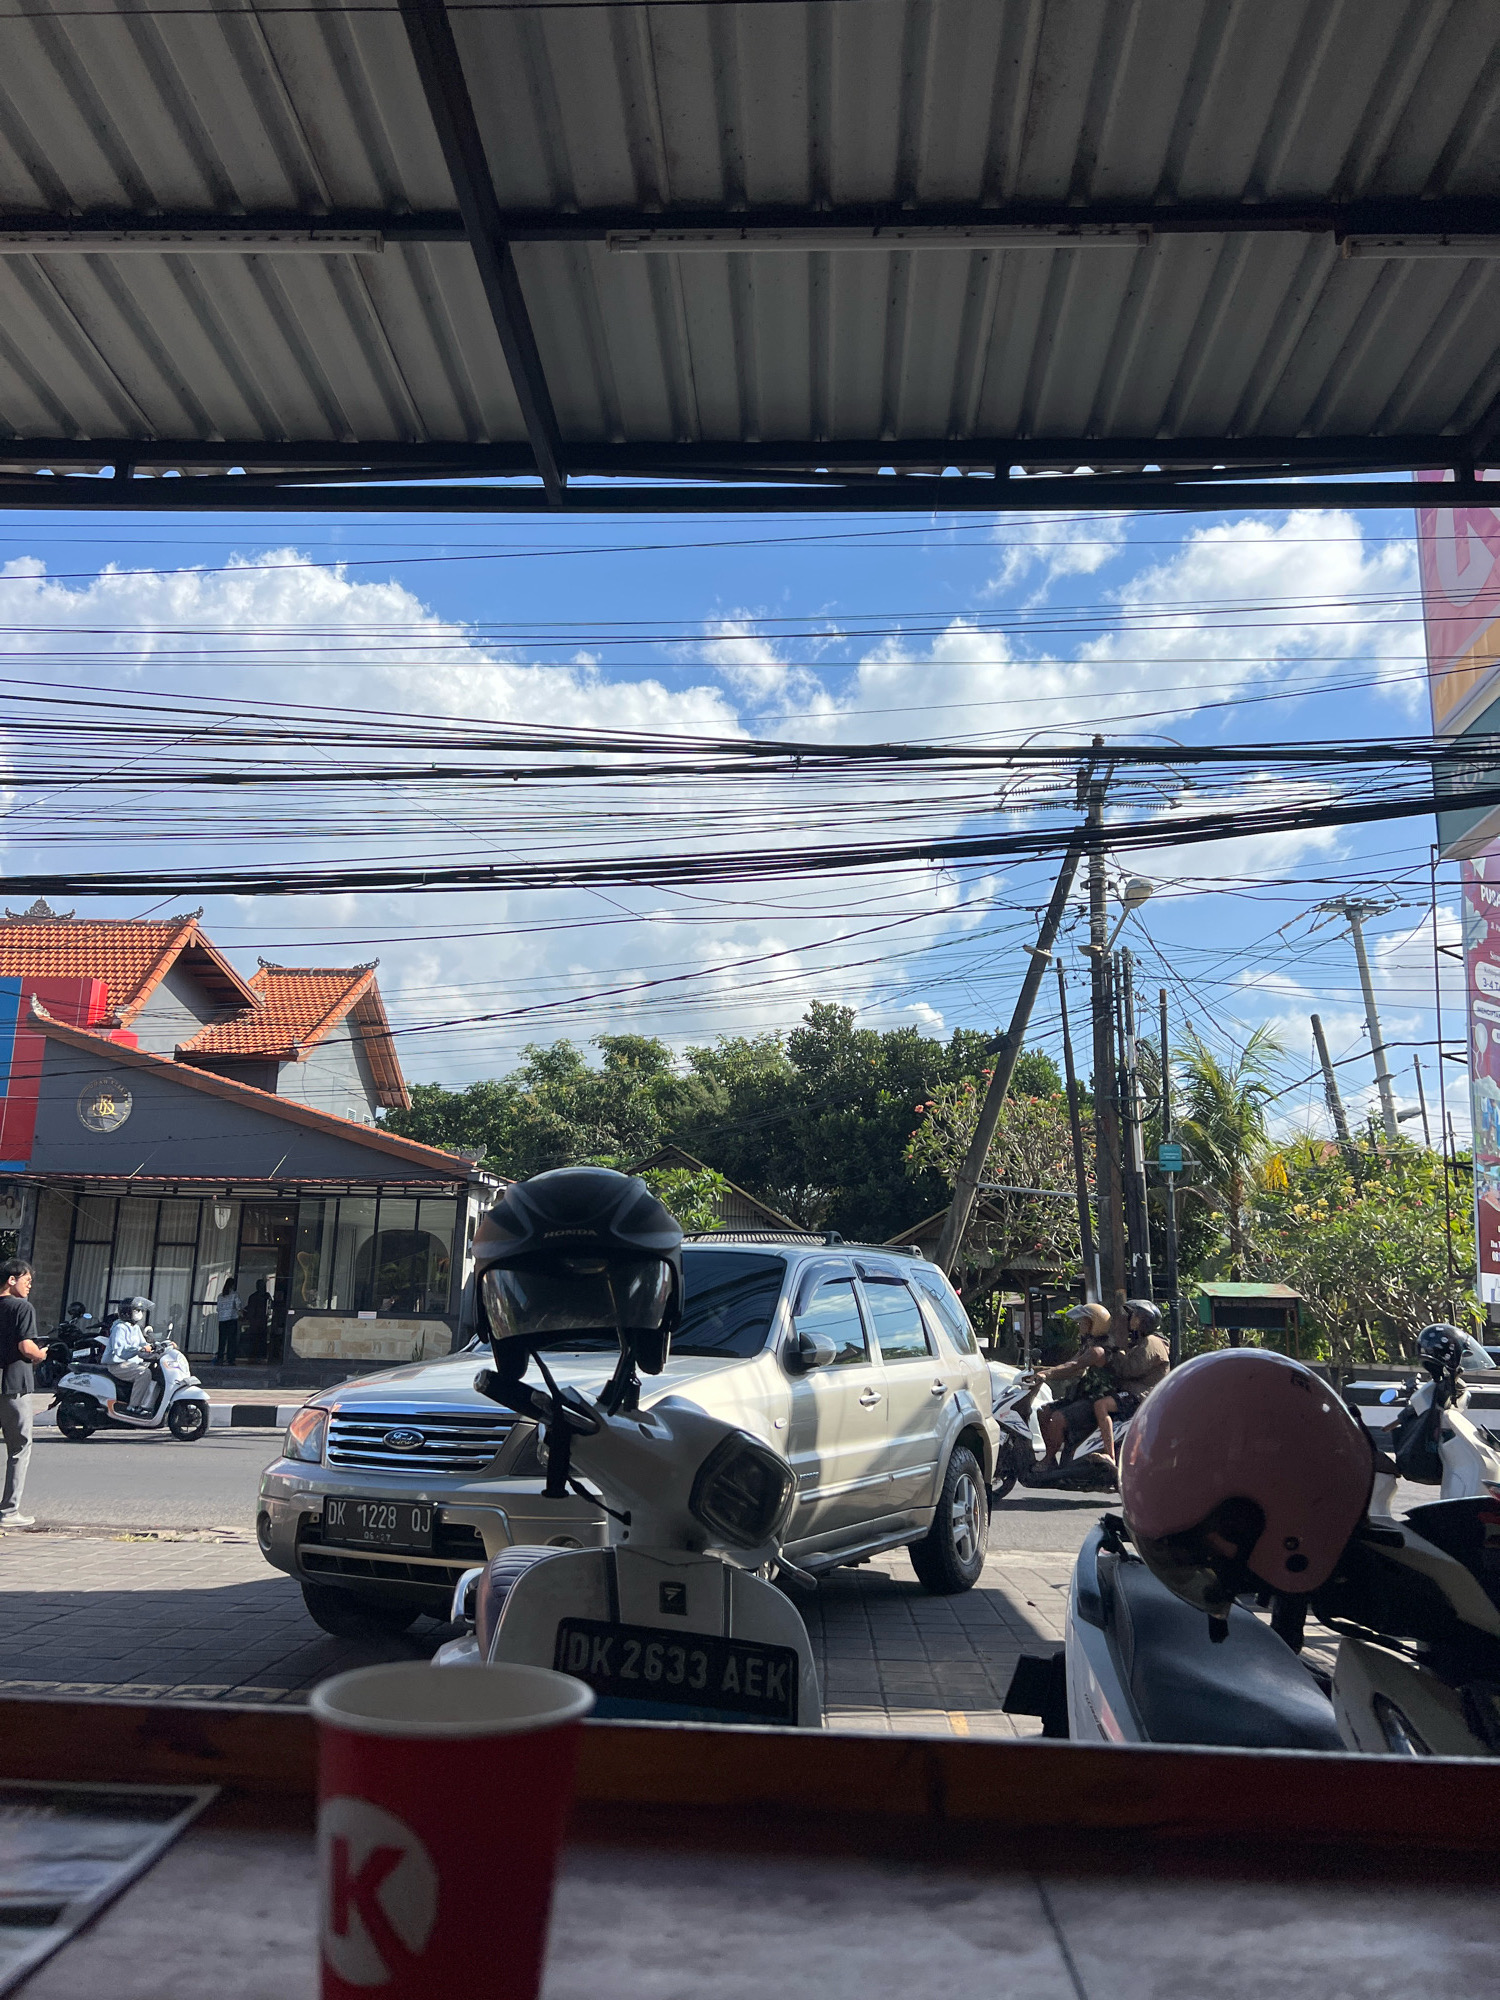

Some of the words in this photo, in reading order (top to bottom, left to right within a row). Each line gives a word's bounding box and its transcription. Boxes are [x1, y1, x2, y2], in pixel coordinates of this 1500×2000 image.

[543, 1229, 598, 1239] HONDA
[327, 1501, 347, 1526] DK
[359, 1503, 398, 1530] 1228
[411, 1508, 432, 1533] QJ
[568, 1631, 614, 1677] DK
[620, 1639, 709, 1690] 2633
[721, 1654, 788, 1701] AEK
[331, 1833, 412, 1980] K
